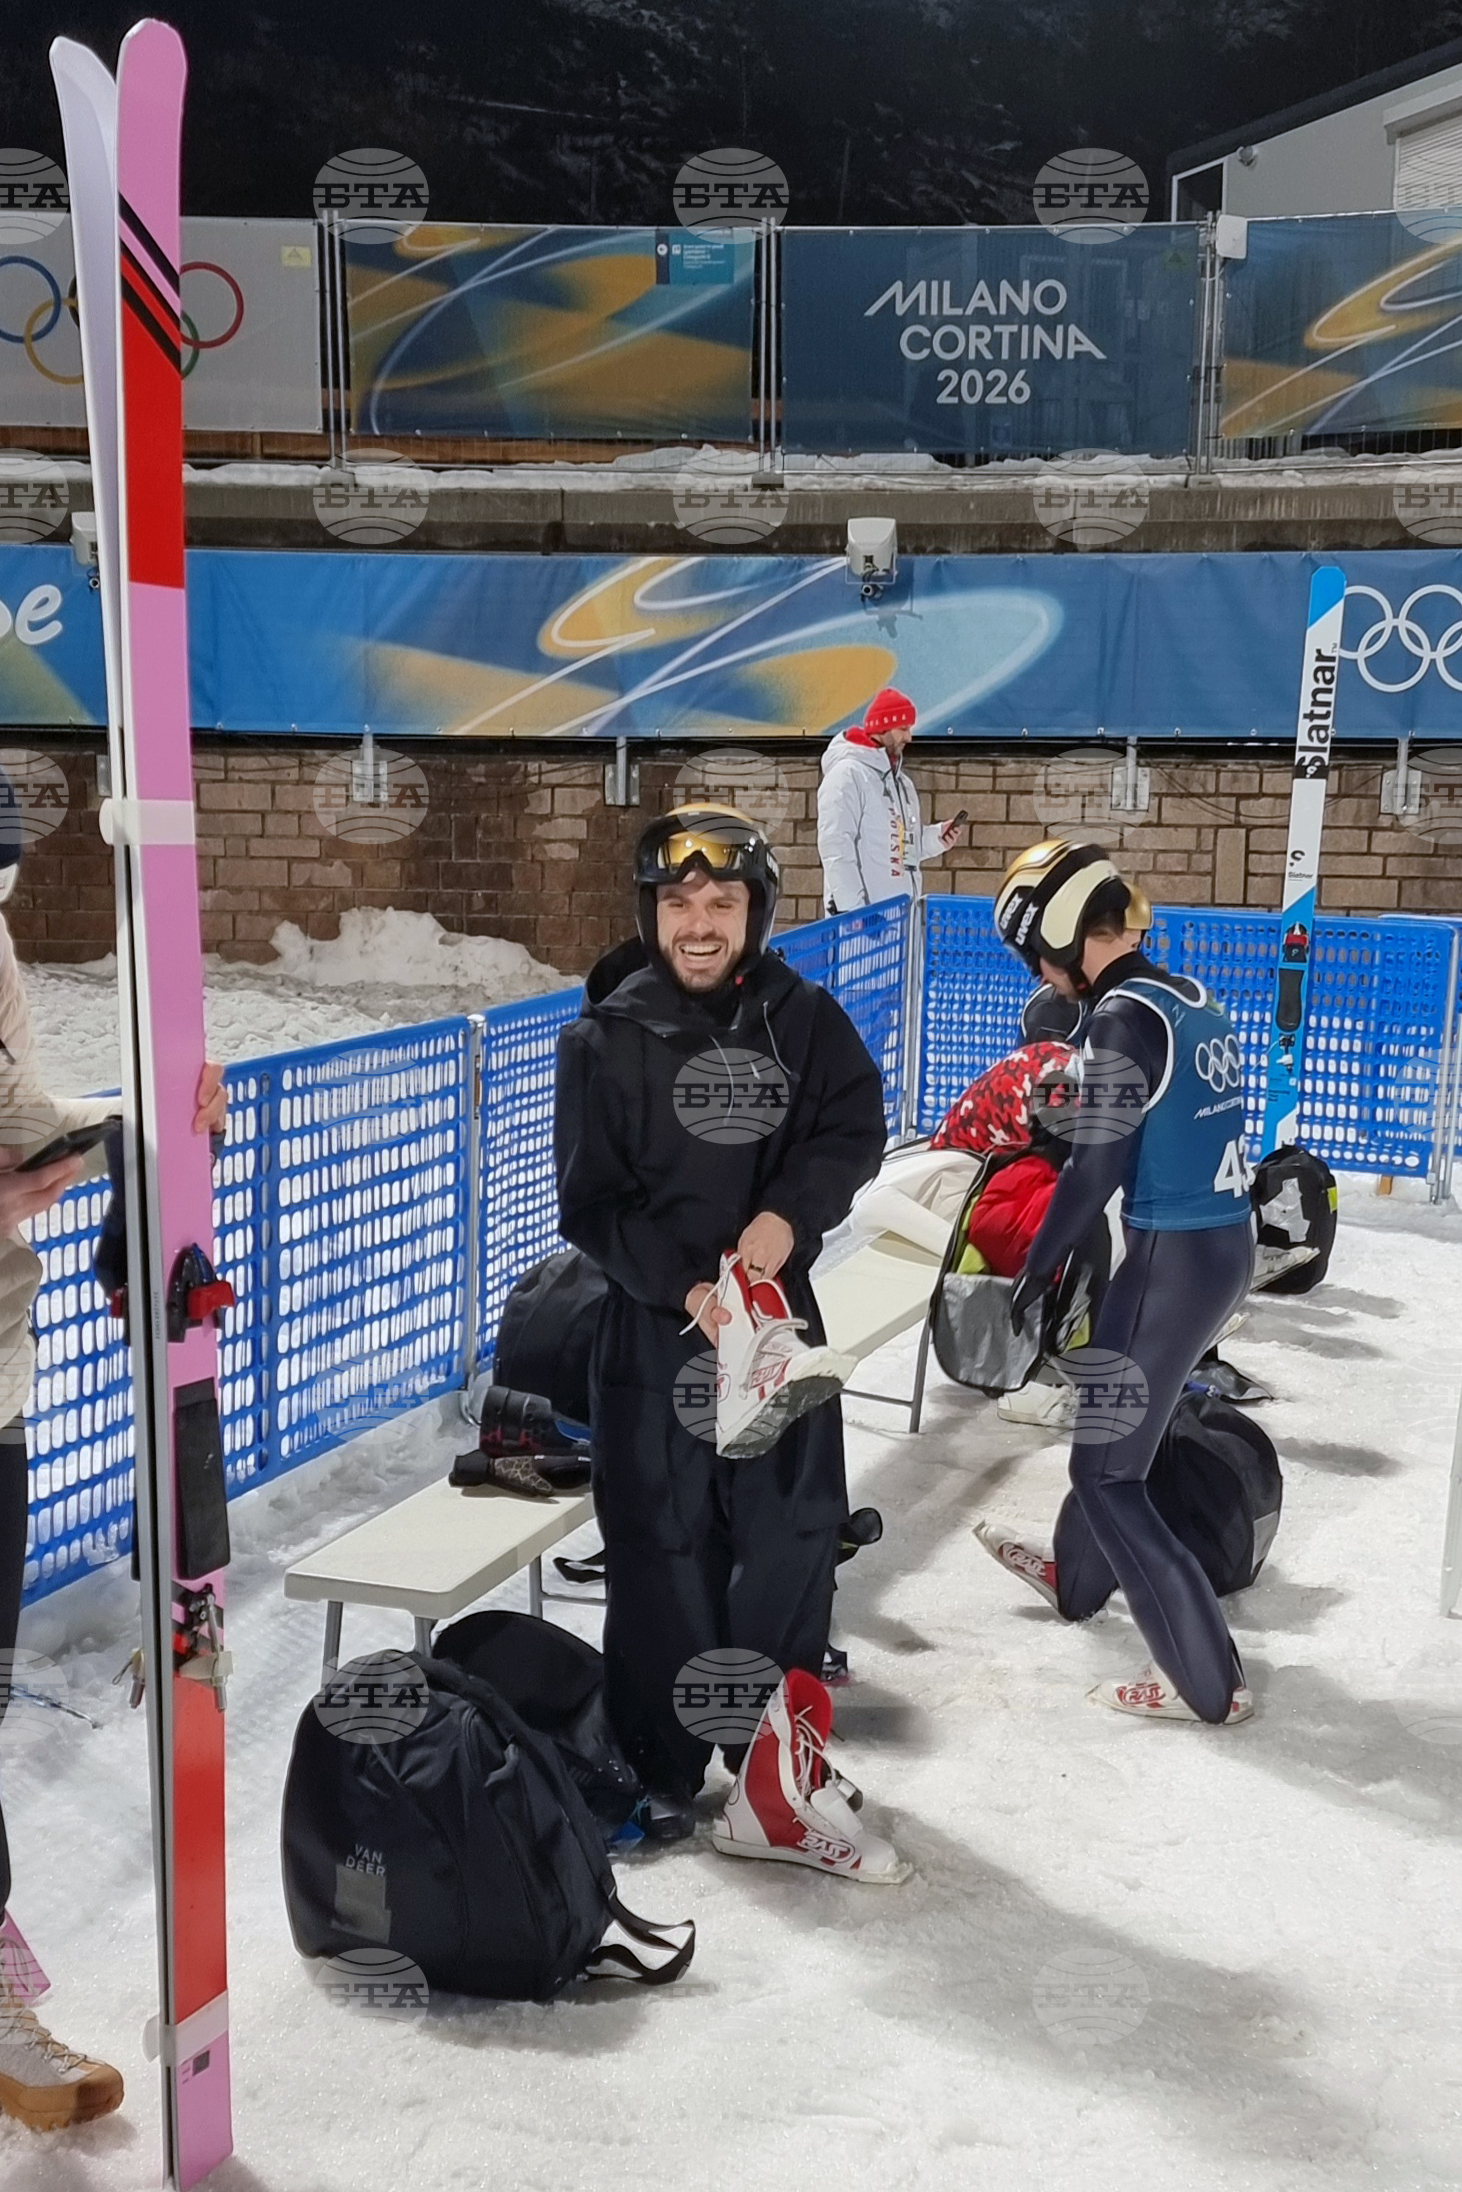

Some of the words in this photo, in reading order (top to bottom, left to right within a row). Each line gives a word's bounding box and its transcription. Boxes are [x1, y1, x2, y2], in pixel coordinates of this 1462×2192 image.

[864, 279, 1068, 317] MILANO
[899, 323, 1108, 361] CORTINA
[936, 369, 1032, 405] 2026
[1297, 648, 1337, 766] Slatnar
[888, 807, 900, 877] POLSKA
[1015, 902, 1039, 946] uvex
[345, 1854, 386, 1876] DEER
[355, 1844, 383, 1864] VAN
